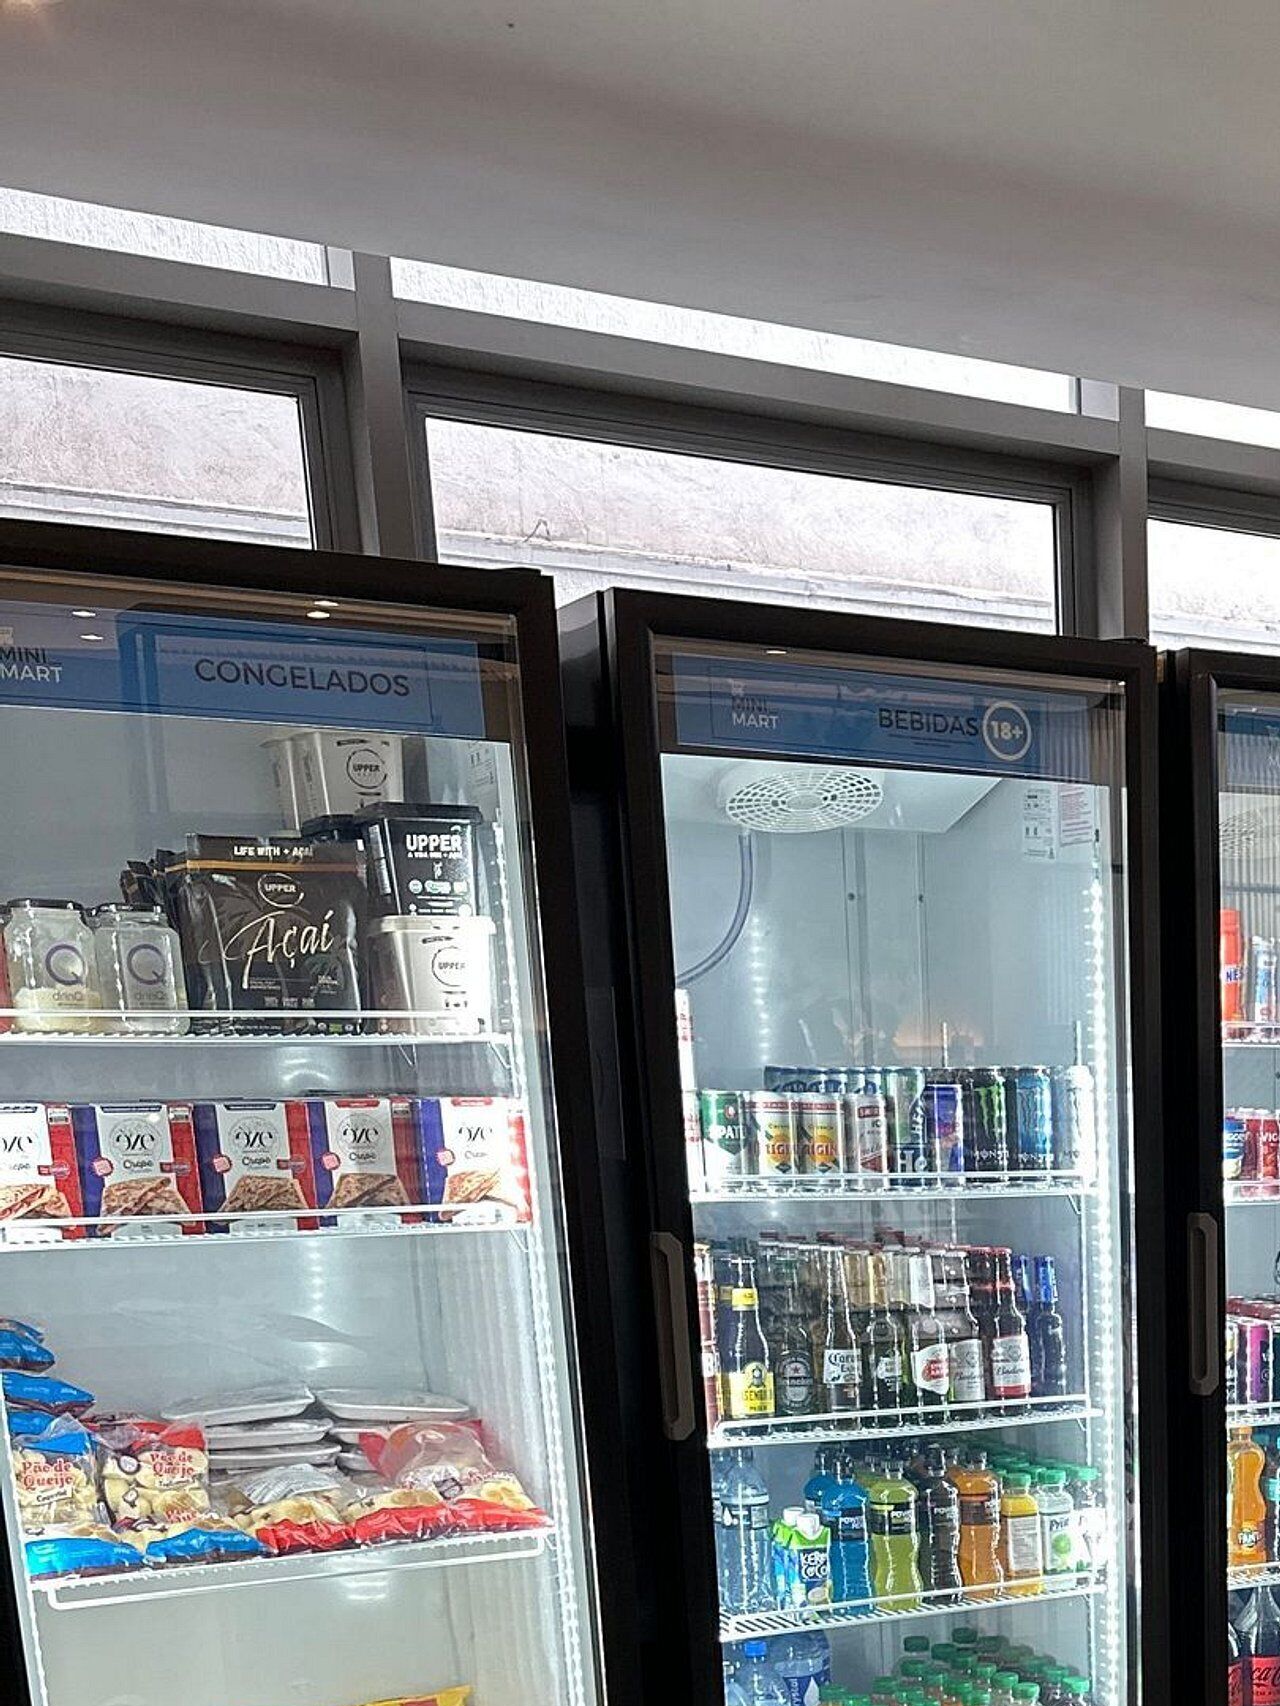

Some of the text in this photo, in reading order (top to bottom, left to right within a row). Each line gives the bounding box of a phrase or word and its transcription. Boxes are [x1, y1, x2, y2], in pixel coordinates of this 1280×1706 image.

[0, 647, 47, 664] MINI
[1, 663, 63, 684] MART
[193, 657, 411, 698] CONGELADOS
[731, 711, 779, 730] MART
[878, 706, 1025, 740] BEBIDAS 18+
[352, 763, 381, 773] UPPER
[233, 846, 255, 856] LIFE
[406, 834, 463, 852] UPPER
[264, 883, 297, 894] UPPER
[53, 1460, 72, 1474] de
